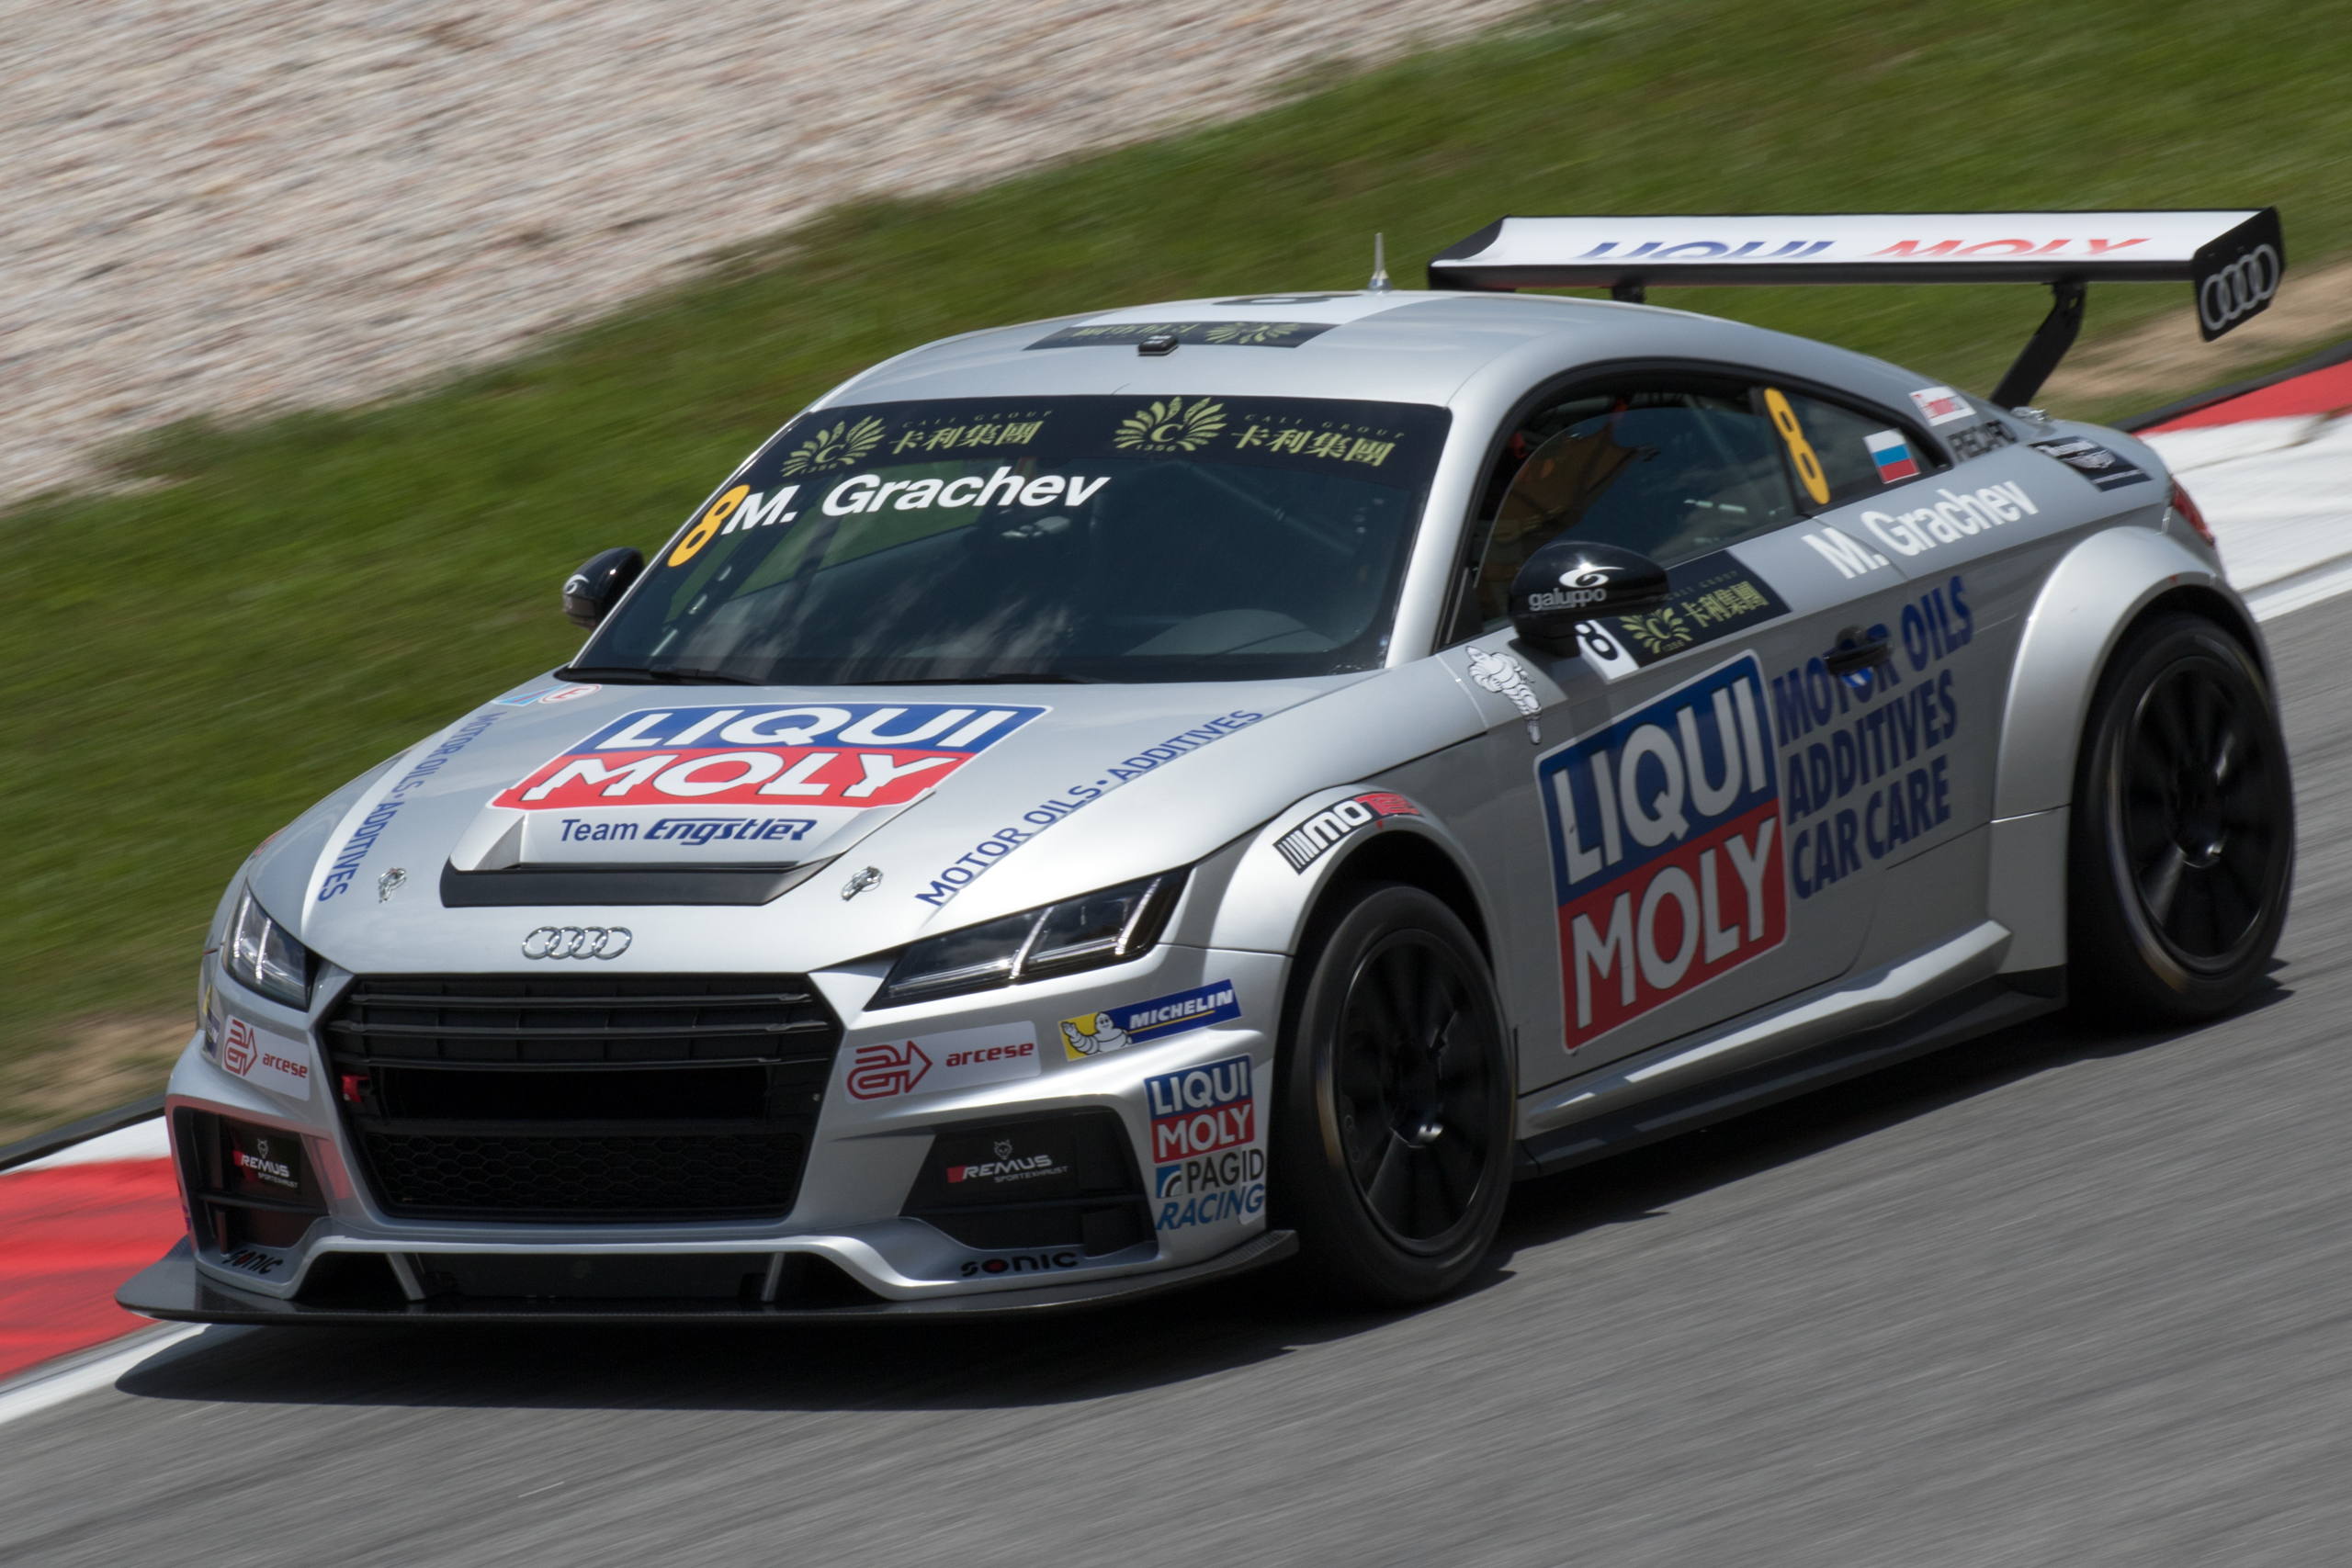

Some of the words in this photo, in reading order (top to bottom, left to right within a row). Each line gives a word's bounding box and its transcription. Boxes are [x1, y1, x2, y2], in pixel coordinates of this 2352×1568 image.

[888, 420, 1045, 455] 卡利集團
[1230, 424, 1396, 467] 卡利集團
[1764, 387, 1830, 505] 8
[721, 484, 800, 536] M.
[821, 466, 1111, 517] Grachev
[667, 484, 751, 568] 8
[1801, 526, 1891, 580] M.
[1860, 480, 2040, 557] Grachev
[1528, 587, 1608, 612] galuppo
[1772, 623, 1902, 749] MOR
[1903, 575, 1975, 672] OILS
[427, 710, 507, 756] MOTOR
[594, 705, 1018, 750] LIQUI
[1787, 668, 1958, 828] ADDITIVES
[390, 757, 448, 794] OILS
[520, 750, 964, 801] MOLY
[1552, 676, 1768, 887] LIQUI
[560, 818, 639, 842] Team
[914, 827, 1035, 907] MOTOR
[1107, 709, 1263, 782] ADDITIVES
[1792, 808, 1864, 900] CAR
[1865, 753, 1951, 879] CARE
[318, 800, 405, 902] ADDITIVES
[1570, 814, 1778, 1031] MOLY
[1129, 988, 1234, 1031] MICHELIN
[262, 1053, 308, 1078] arcese
[945, 1042, 1035, 1068] arcese
[1150, 1061, 1249, 1116] LIQUI
[1158, 1103, 1252, 1159] MOLY
[241, 1154, 290, 1179] REMUS
[962, 1154, 1052, 1180] REMUS
[1187, 1148, 1265, 1194] PAGID
[1156, 1183, 1267, 1231] RACING
